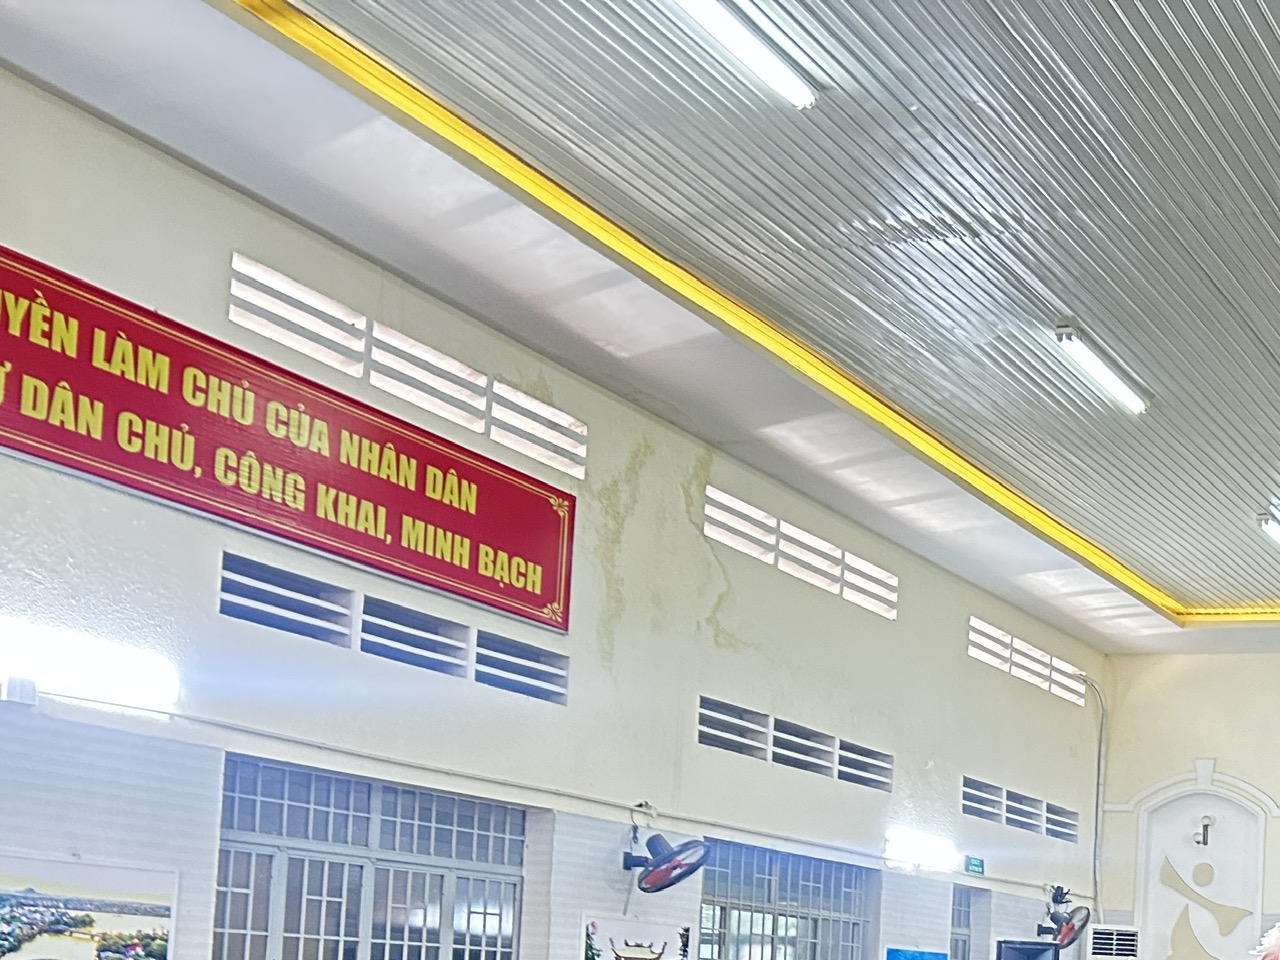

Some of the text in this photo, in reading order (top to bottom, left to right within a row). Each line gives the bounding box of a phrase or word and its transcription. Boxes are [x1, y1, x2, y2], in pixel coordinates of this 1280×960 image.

[0, 288, 479, 516] YỀN LÀM CHỦ CỦA NHÂN DÂN
[20, 374, 104, 441] DÂN
[116, 410, 203, 478] CHỦ,
[214, 447, 307, 511] CÔNG
[316, 484, 392, 545] KHAI,
[401, 513, 470, 571] MINH
[478, 543, 543, 595] BẠCH
